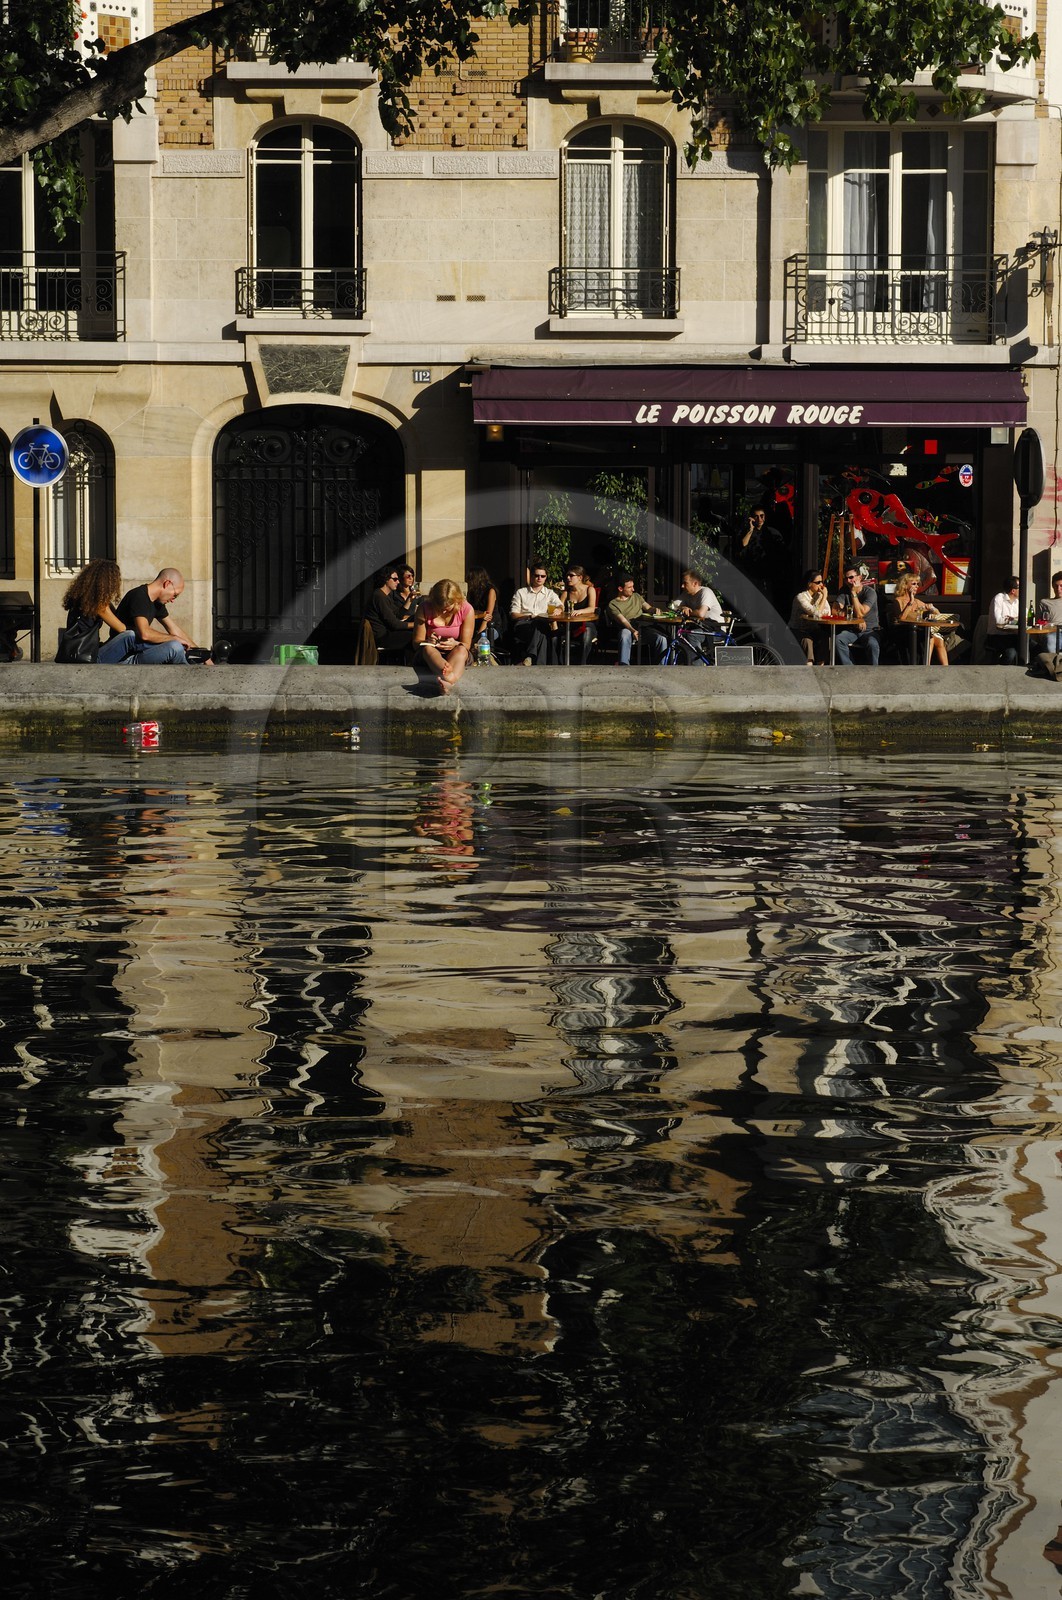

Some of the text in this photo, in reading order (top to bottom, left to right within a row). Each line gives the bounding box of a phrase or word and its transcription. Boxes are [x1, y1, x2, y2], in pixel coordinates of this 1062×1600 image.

[414, 371, 431, 382] 112
[635, 404, 864, 424] LE POISSON ROUGE
